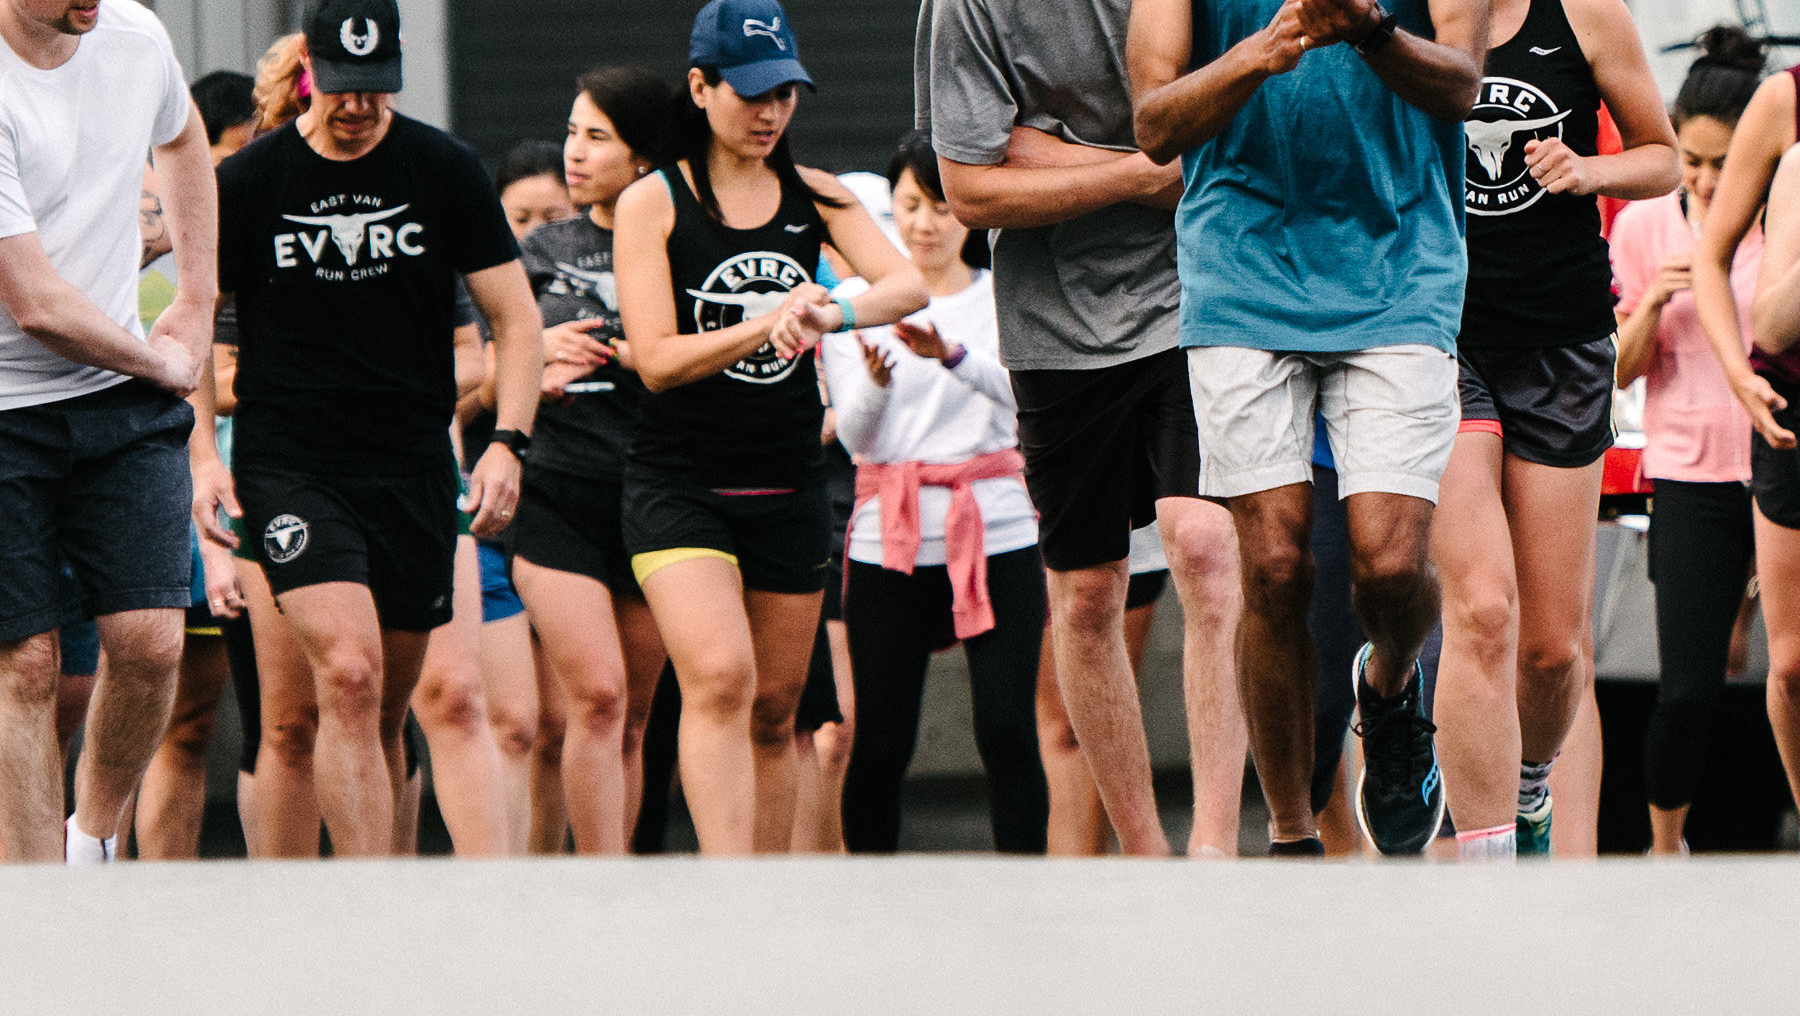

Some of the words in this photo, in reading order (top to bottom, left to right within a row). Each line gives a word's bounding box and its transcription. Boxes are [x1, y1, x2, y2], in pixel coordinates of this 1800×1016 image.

[1475, 83, 1537, 113] RC
[309, 193, 347, 214] EAST
[352, 193, 383, 208] VAN
[1497, 183, 1530, 205] RUN
[314, 266, 345, 281] RUN
[350, 262, 389, 282] CREW
[719, 258, 799, 290] EVRC
[735, 359, 757, 374] AN
[761, 357, 790, 374] RUN
